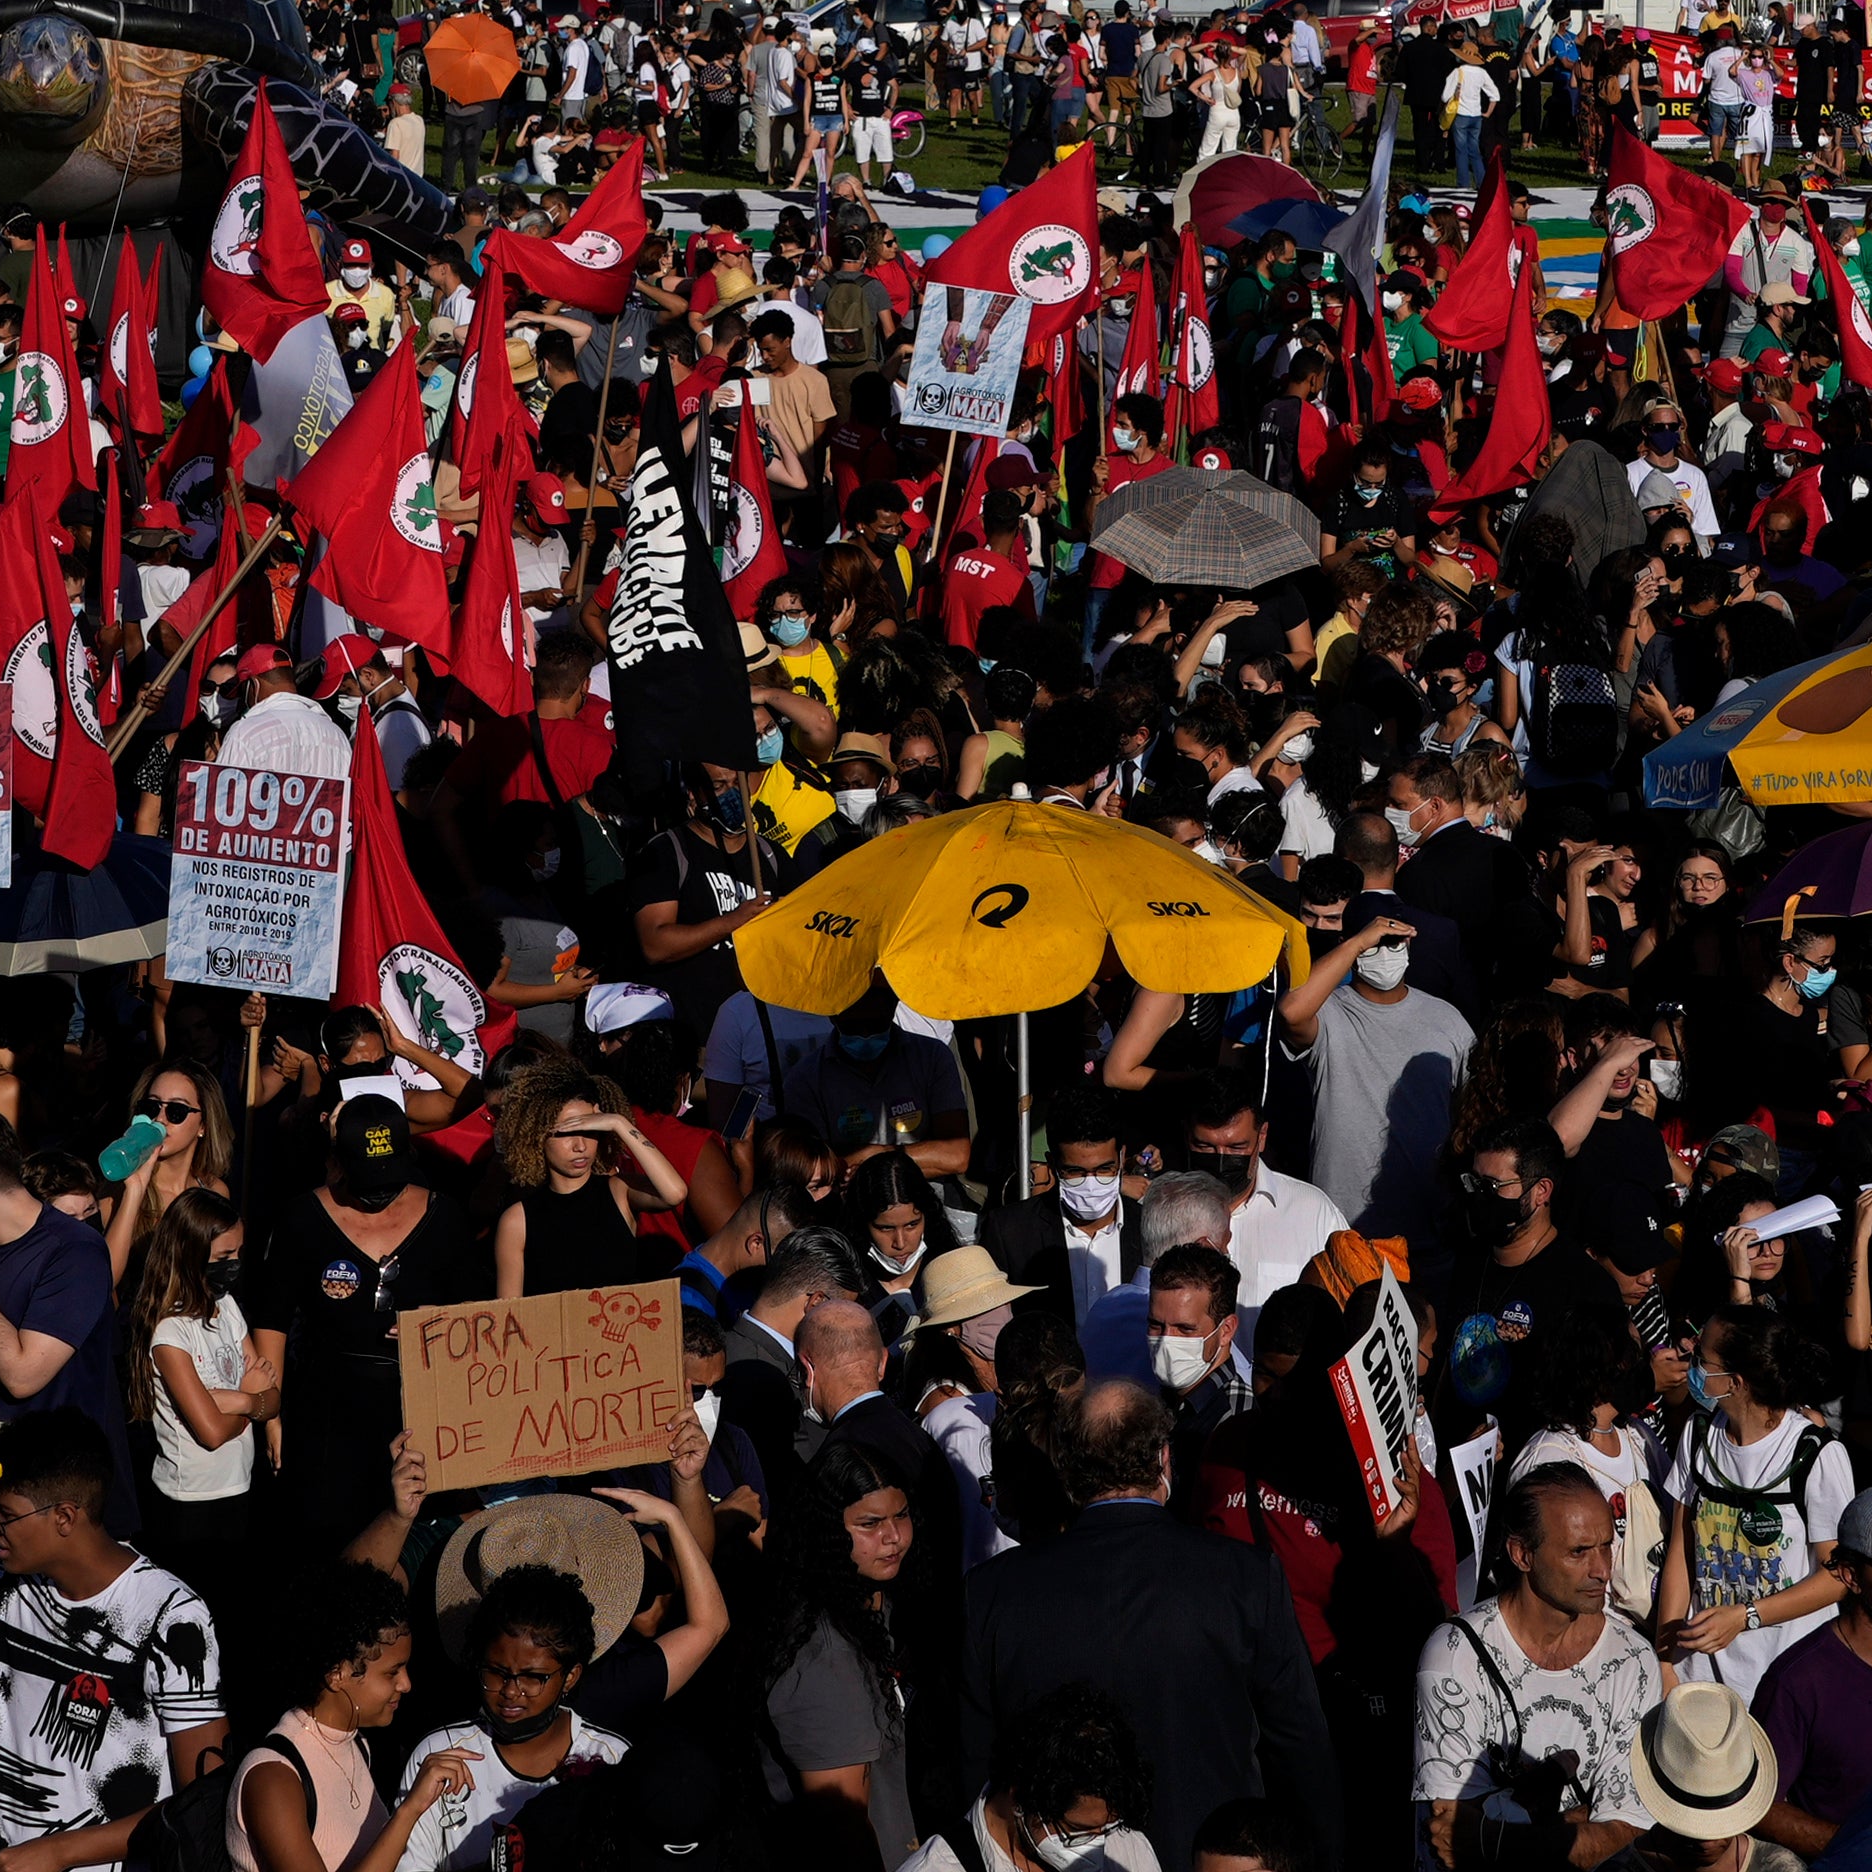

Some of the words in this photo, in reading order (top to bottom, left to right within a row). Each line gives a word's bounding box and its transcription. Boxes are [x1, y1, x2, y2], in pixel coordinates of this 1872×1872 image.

[1456, 2, 1485, 17] KIBON
[1498, 0, 1515, 8] KIBON
[953, 385, 1007, 401] AGROTÓXICO
[950, 394, 1003, 424] MATA
[1792, 438, 1807, 447] MST
[954, 556, 996, 579] MST
[5, 633, 38, 684] OVIMENTO
[68, 626, 79, 706] TRABALHADO
[76, 702, 88, 726] DOS
[20, 728, 50, 756] BRASIL
[1655, 764, 1687, 796] PODE
[1689, 759, 1709, 789] SIM
[1751, 773, 1799, 792] #TUDO
[1802, 771, 1837, 790] VIRA
[185, 765, 335, 838] 109%
[181, 827, 209, 853] DE
[217, 831, 331, 869] AUMENTO
[192, 860, 218, 877] NOS
[222, 863, 296, 886] REGISTROS
[299, 872, 316, 889] DE
[194, 881, 280, 906] INTOXICAÇÃO
[283, 891, 311, 909] POR
[205, 902, 297, 928] AGROTÓXICOS
[1147, 901, 1211, 918] SKOL
[208, 920, 236, 934] ENTRE
[238, 923, 261, 937] 2010
[262, 927, 269, 937] E
[269, 928, 292, 941] 2019
[804, 910, 861, 939] SKOL
[242, 949, 292, 964] AGROTÓXICO
[241, 957, 291, 984] MATA
[891, 1101, 916, 1116] FORA
[365, 1128, 391, 1138] CAR
[416, 1310, 532, 1370] FORA
[1382, 1288, 1417, 1411] RACISMO
[434, 1420, 487, 1461] DE
[510, 1378, 678, 1459] MORTE
[67, 1701, 101, 1720] FORA!
